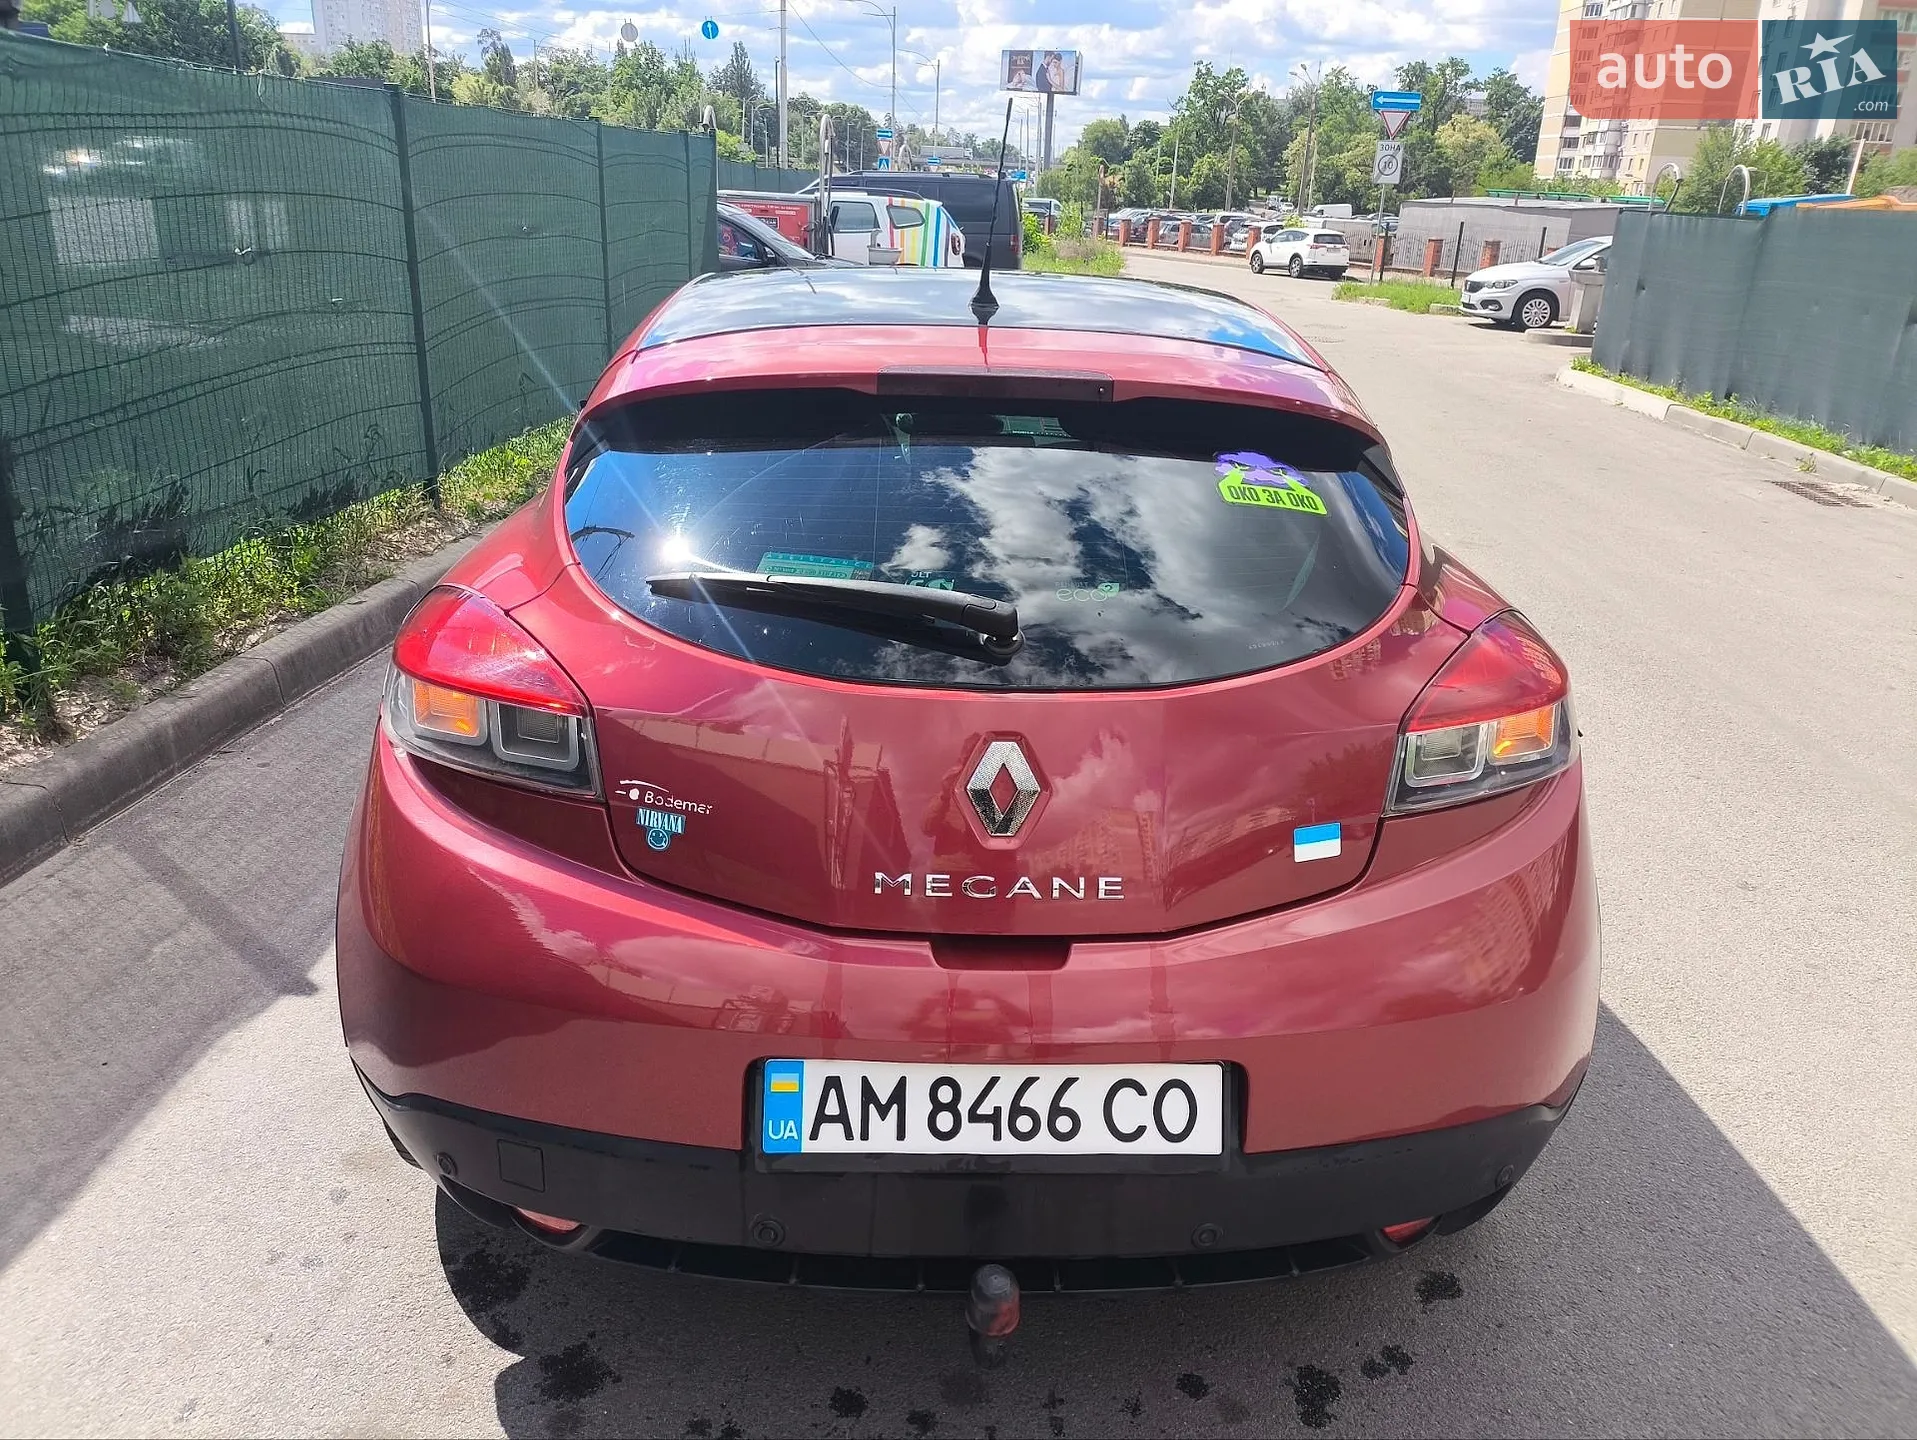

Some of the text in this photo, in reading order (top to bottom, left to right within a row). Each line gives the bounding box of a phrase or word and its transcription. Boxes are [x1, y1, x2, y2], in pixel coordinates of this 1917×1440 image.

[1380, 143, 1401, 151] ЗОНА
[1383, 161, 1393, 170] 10
[1226, 485, 1320, 511] ОКО ЗА ОКО
[636, 807, 683, 834] NIRVANA
[874, 871, 1125, 900] MEGANE
[808, 1075, 1198, 1143] AM 8466 CO
[768, 1119, 799, 1141] UA
